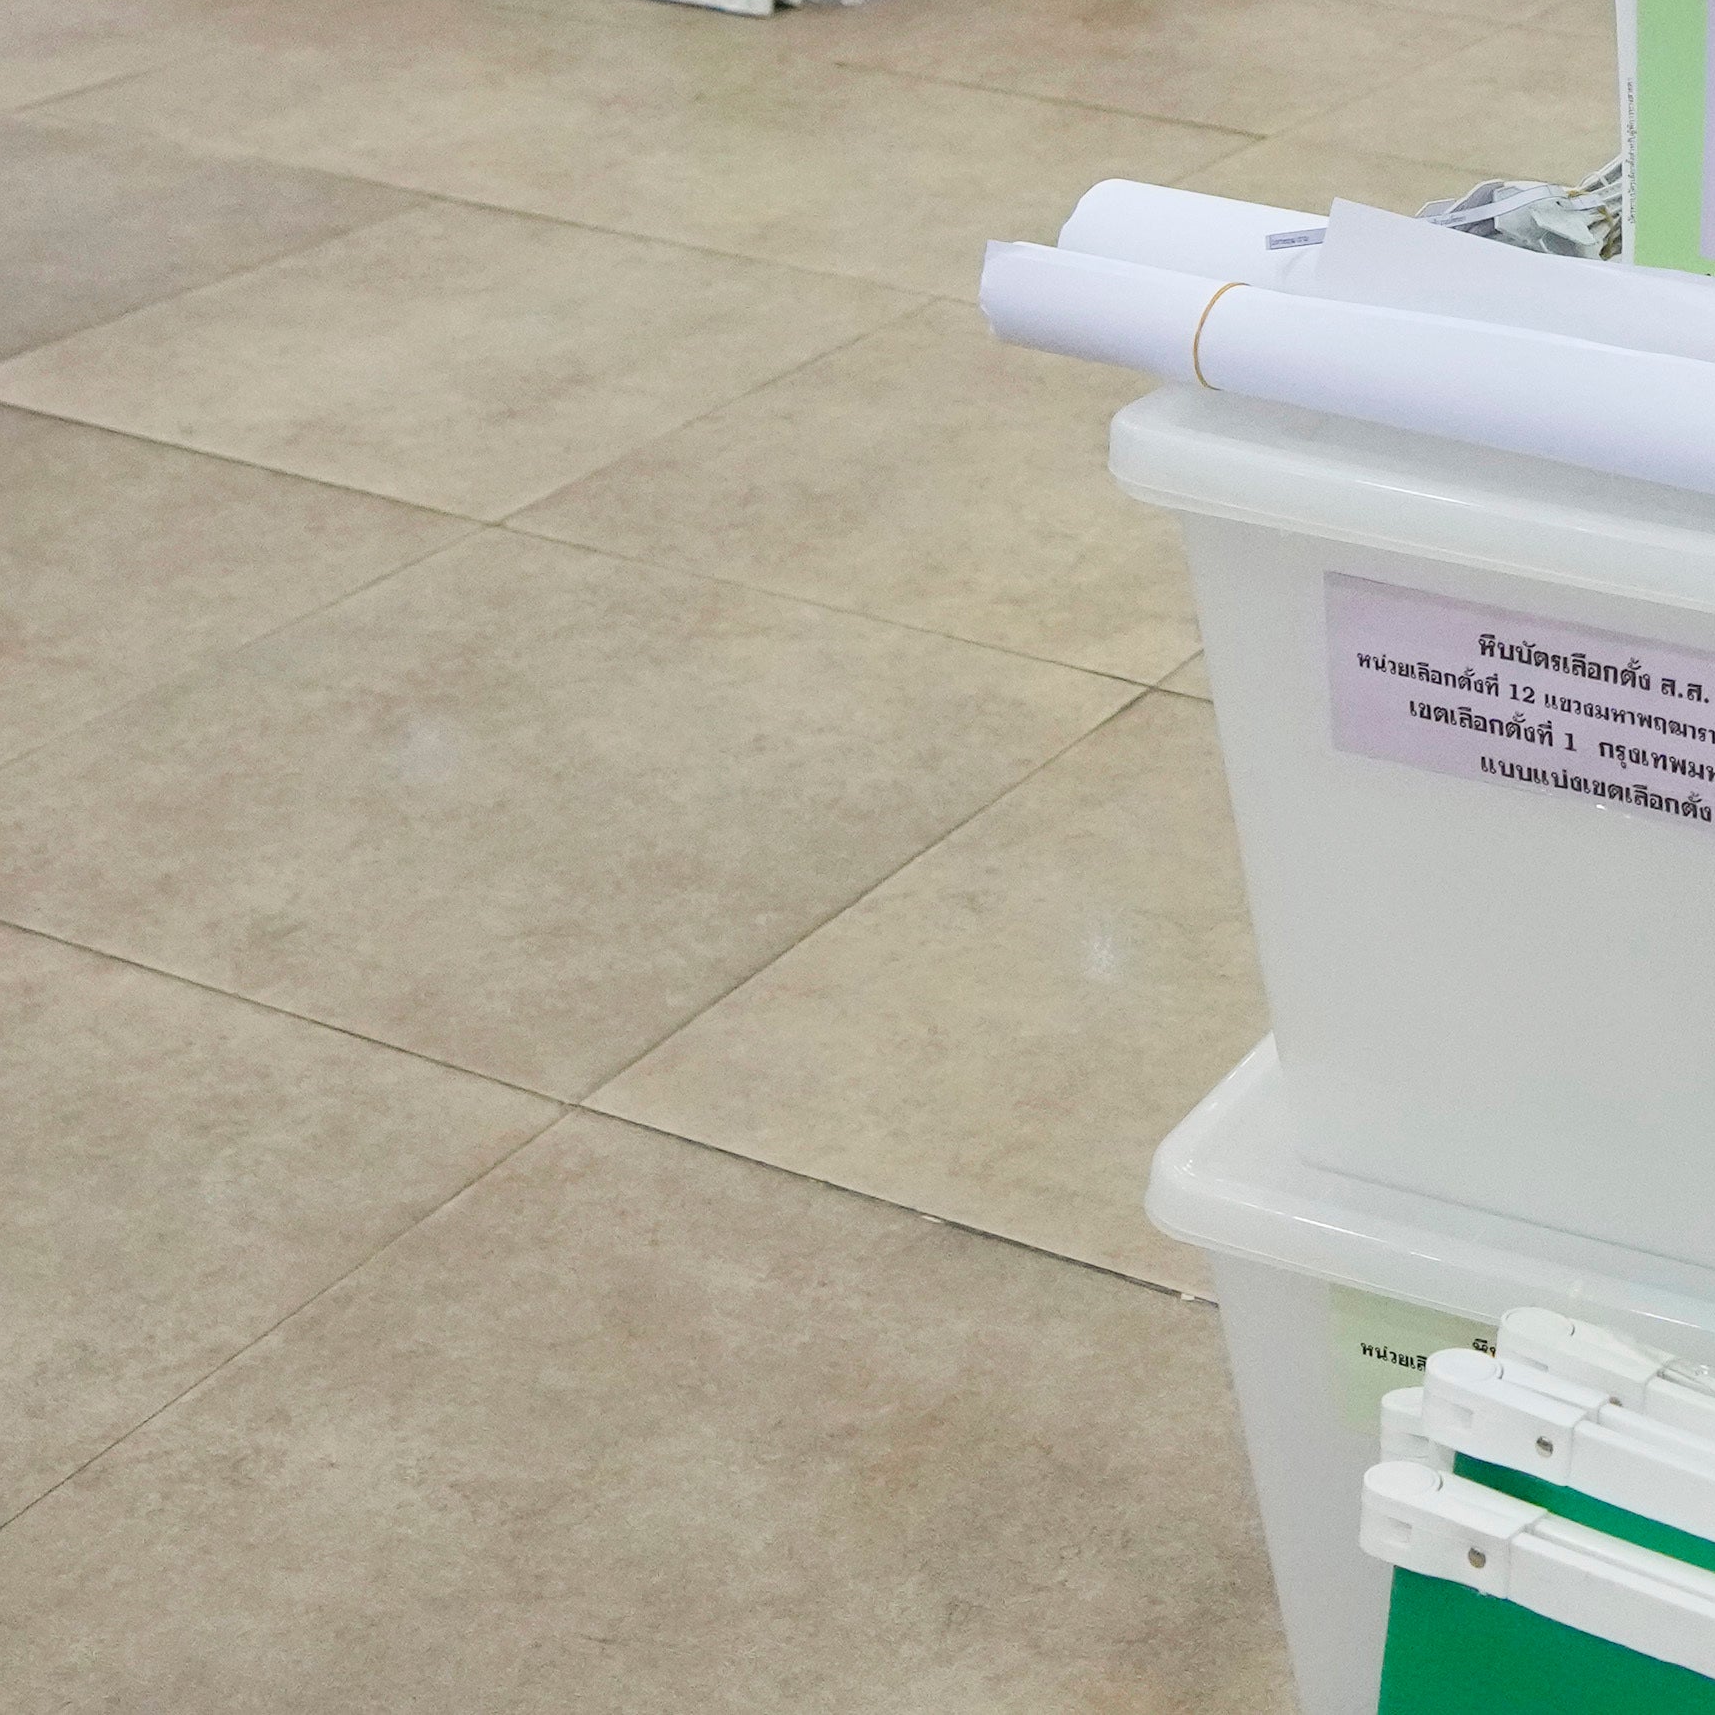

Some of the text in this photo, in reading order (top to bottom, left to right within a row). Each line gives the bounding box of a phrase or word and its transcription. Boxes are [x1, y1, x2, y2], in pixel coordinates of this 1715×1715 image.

[1357, 647, 1500, 698] หน่วยเลือกตั้งที่
[1509, 683, 1536, 703] 12
[1477, 633, 1710, 704] หีบบัตรเลือกตั้ง ส.ส.
[1409, 700, 1554, 748] เขตเลือกตั้งที่
[1564, 731, 1576, 752] 1
[1481, 755, 1712, 823] แบบแบ่งเขตเลือกตั้ง
